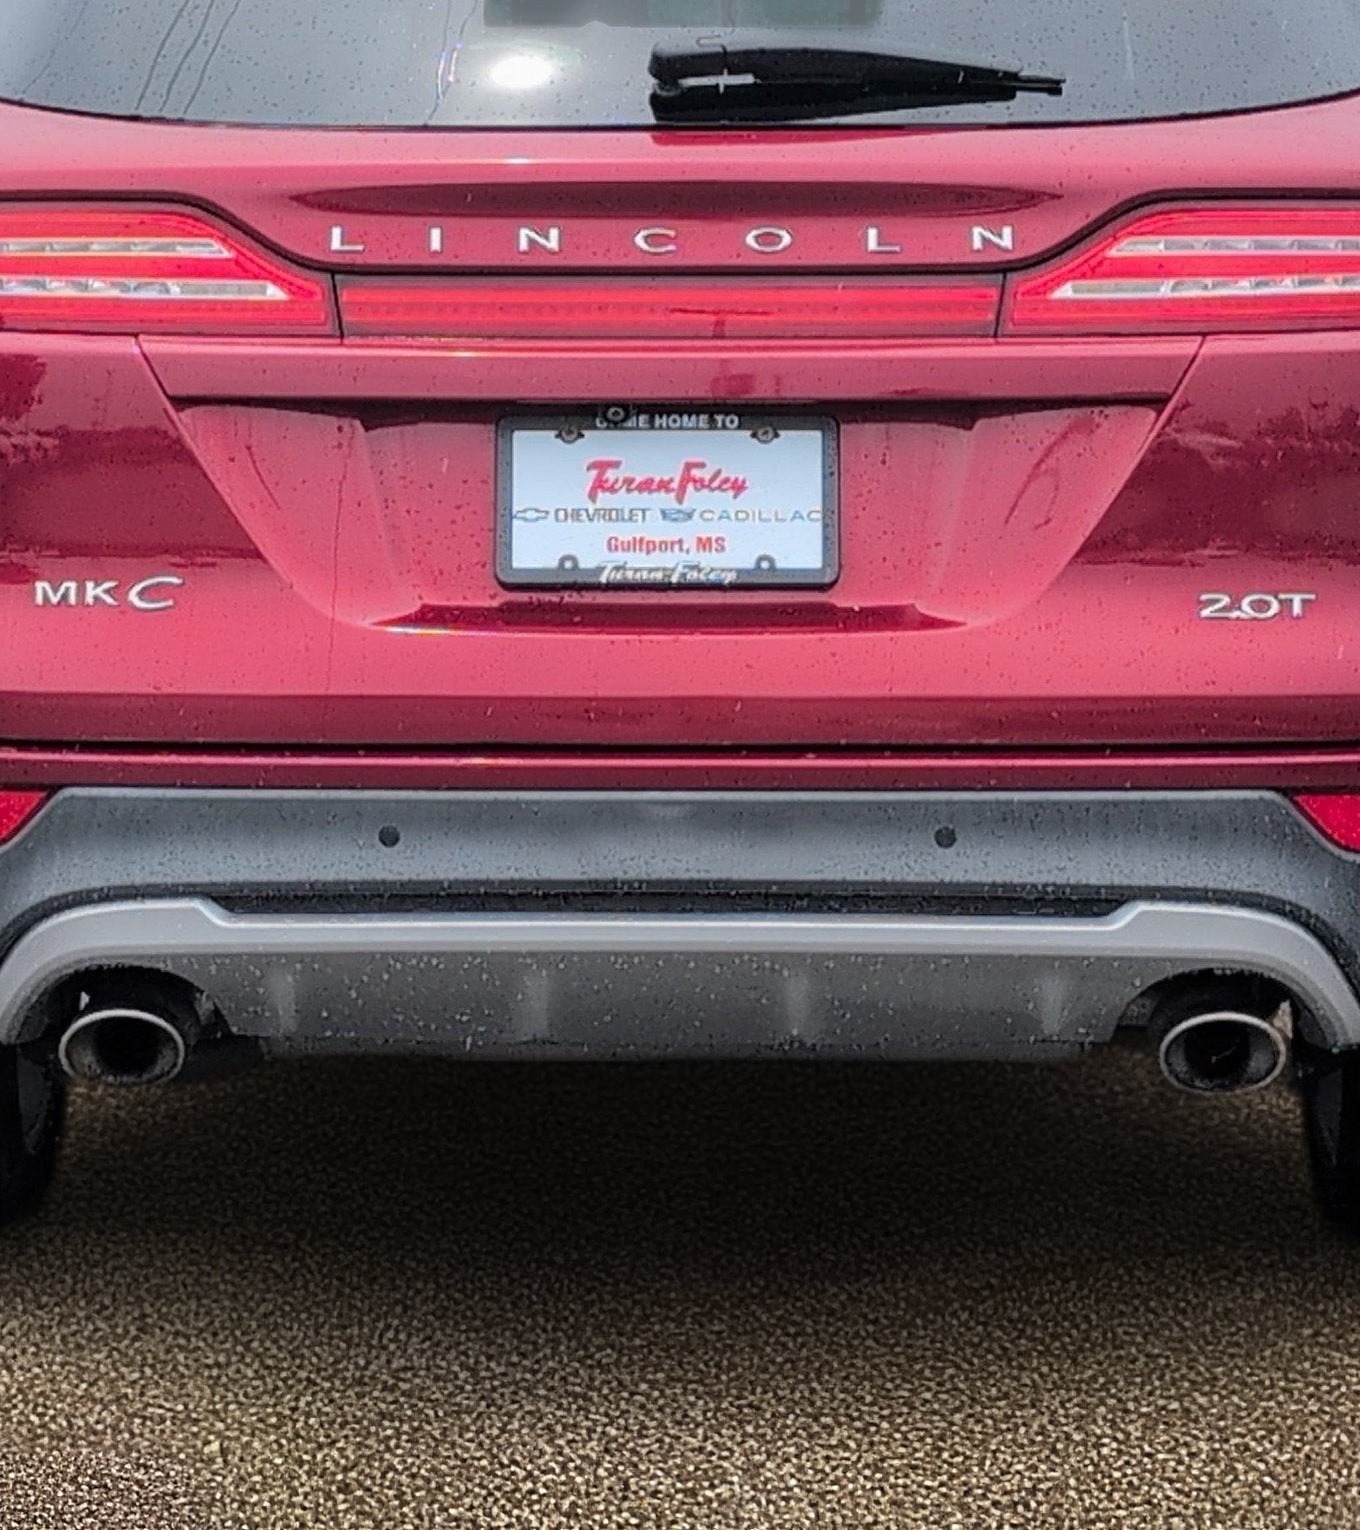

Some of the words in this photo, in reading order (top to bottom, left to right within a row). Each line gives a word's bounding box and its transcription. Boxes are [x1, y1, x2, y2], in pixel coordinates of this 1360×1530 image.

[330, 225, 1014, 254] LINCOLN
[653, 413, 709, 429] HOME
[713, 413, 740, 429] TO
[553, 507, 652, 523] CHEVROLET
[699, 509, 822, 522] CADILLAC
[606, 535, 690, 555] Gulfport,
[695, 535, 727, 553] MS
[34, 575, 185, 611] MKC
